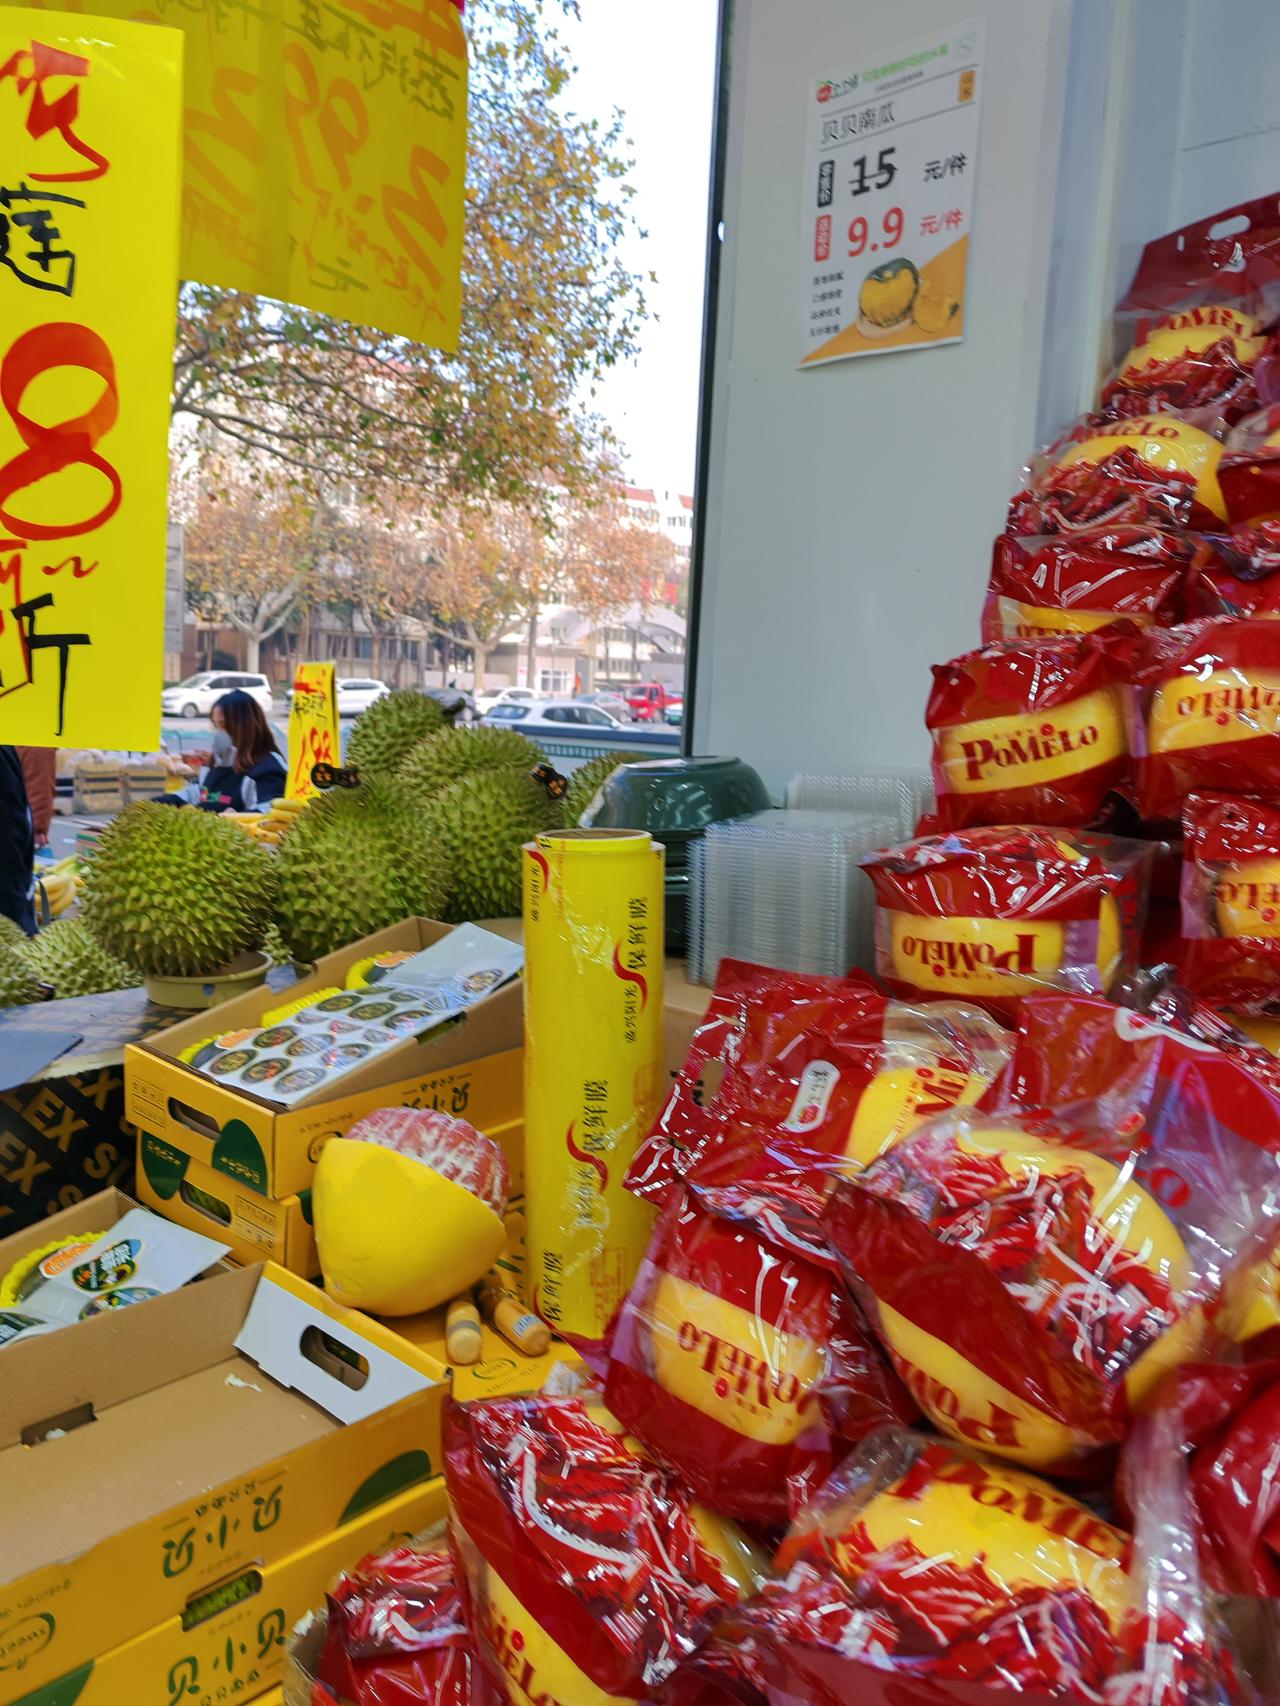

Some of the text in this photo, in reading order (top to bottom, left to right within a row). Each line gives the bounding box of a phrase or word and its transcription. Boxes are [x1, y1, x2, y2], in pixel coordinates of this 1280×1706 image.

[821, 101, 895, 145] 贝贝南瓜
[850, 146, 897, 197] 15
[922, 152, 968, 183] 元/件
[847, 206, 904, 258] 9.9
[960, 724, 1099, 781] POMELO
[903, 933, 1040, 976] POMELO
